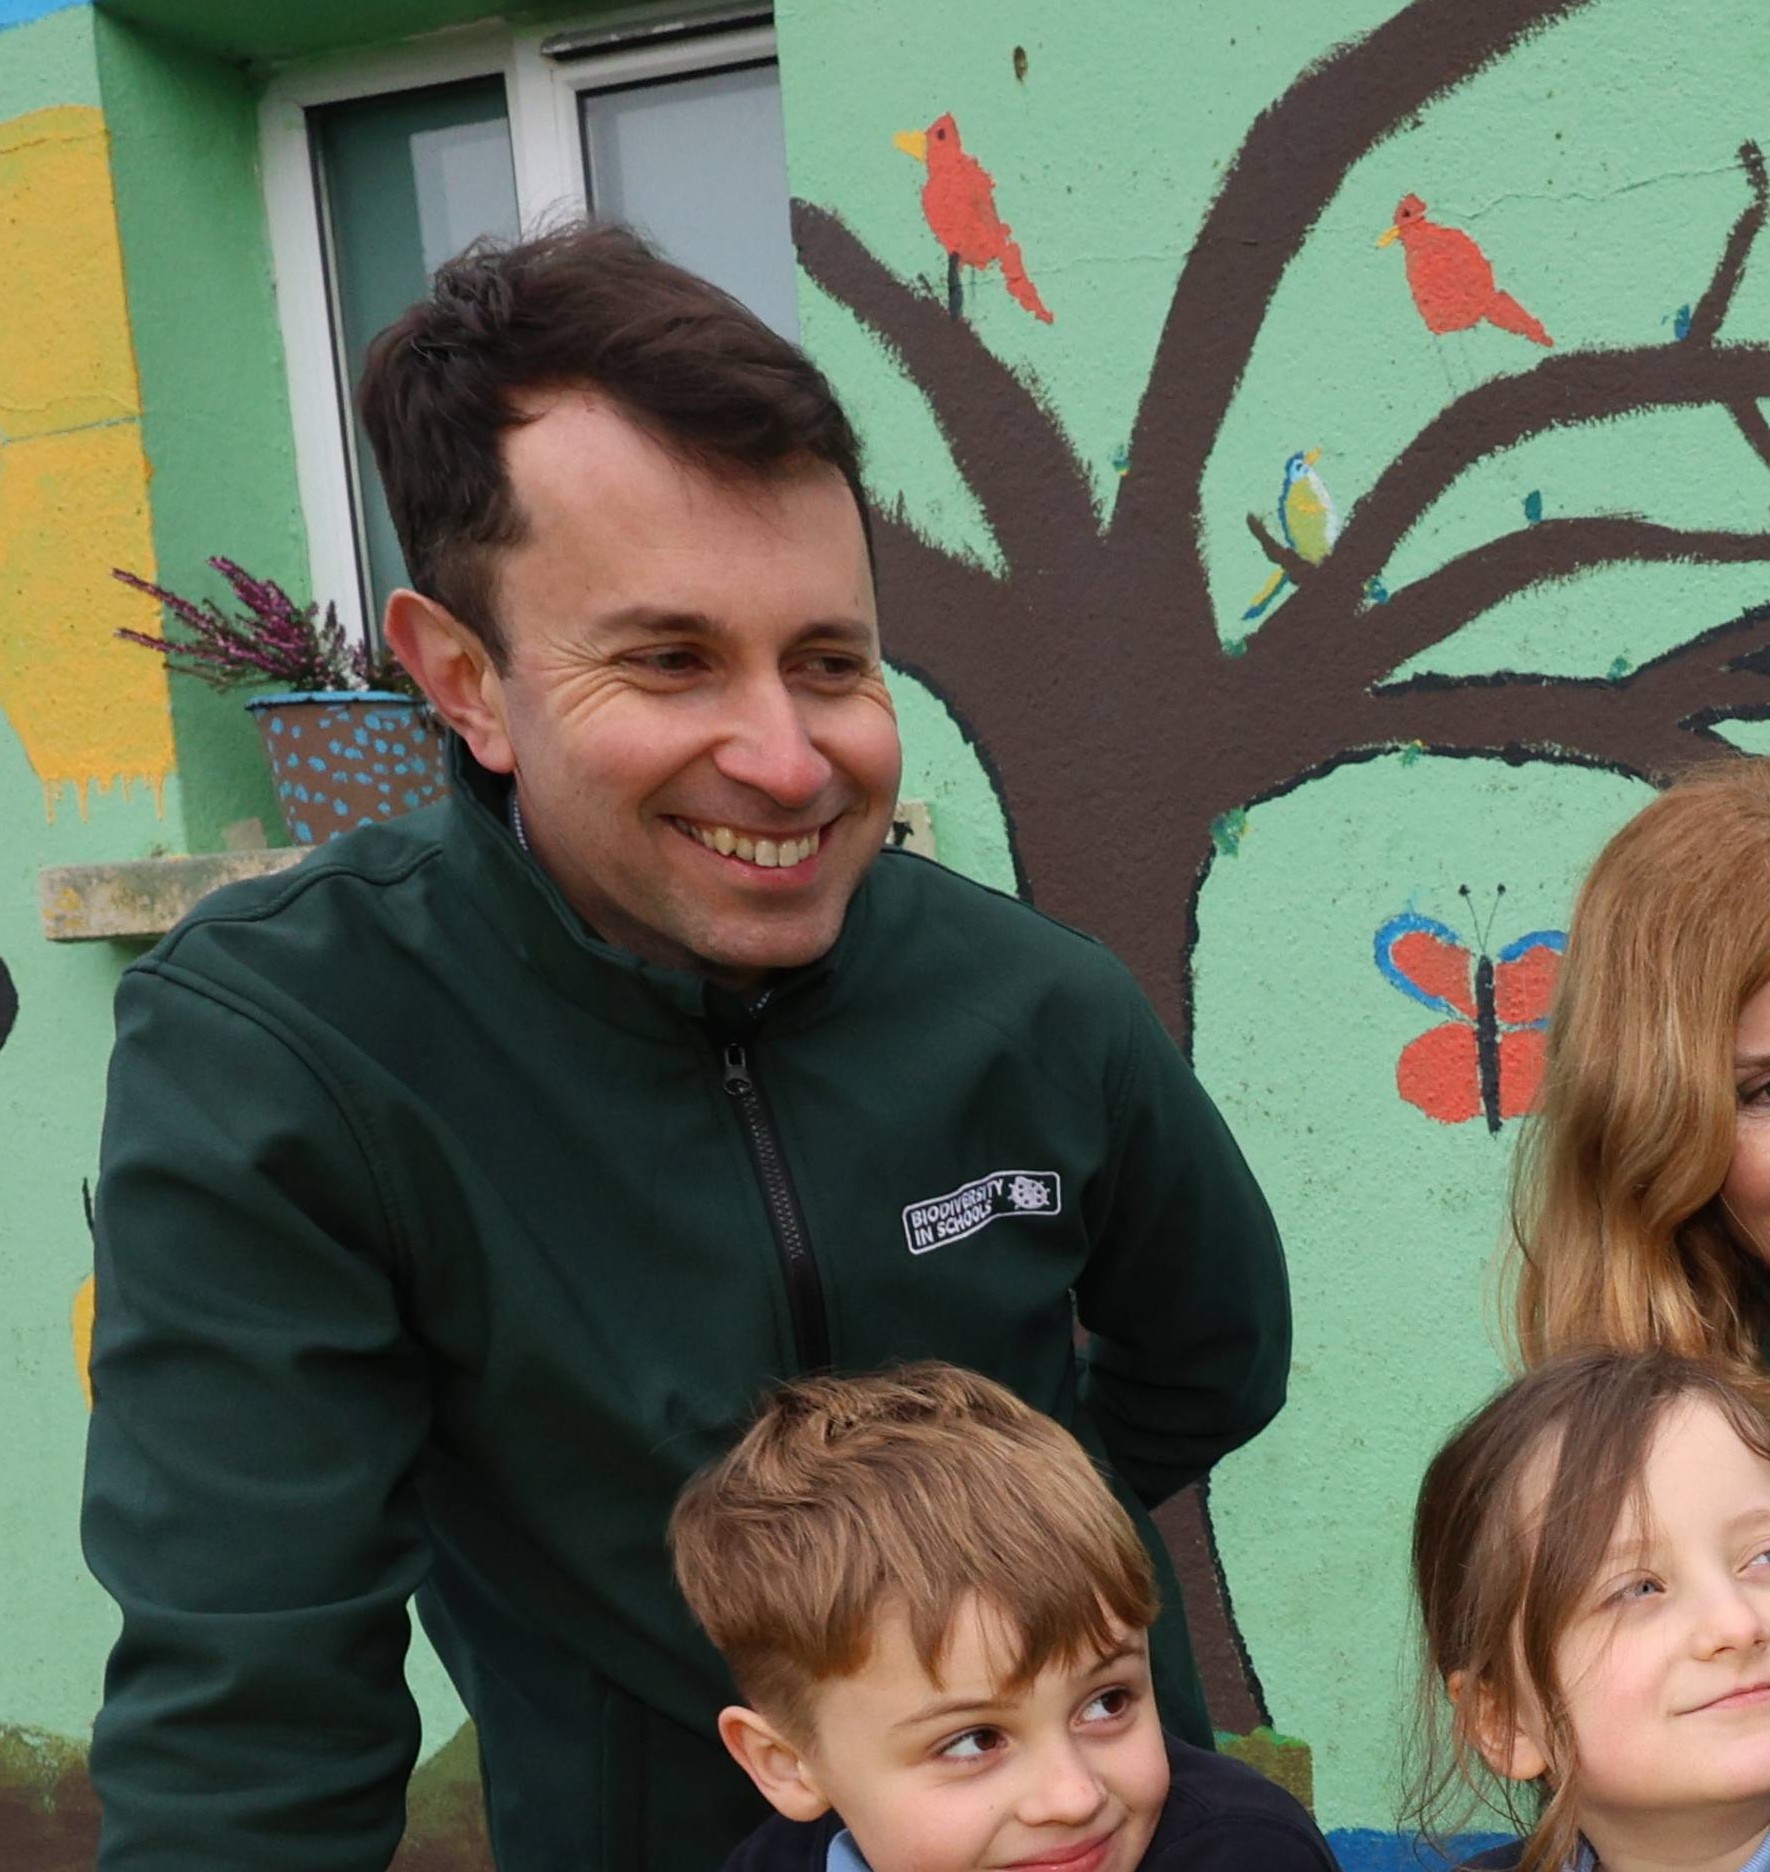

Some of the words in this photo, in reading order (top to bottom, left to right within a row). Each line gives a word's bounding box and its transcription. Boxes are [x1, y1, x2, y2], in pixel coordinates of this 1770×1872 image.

[910, 1177, 1005, 1229] BIODIVERSITY
[914, 1226, 935, 1248] IN
[936, 1199, 993, 1239] SCHOOLS
